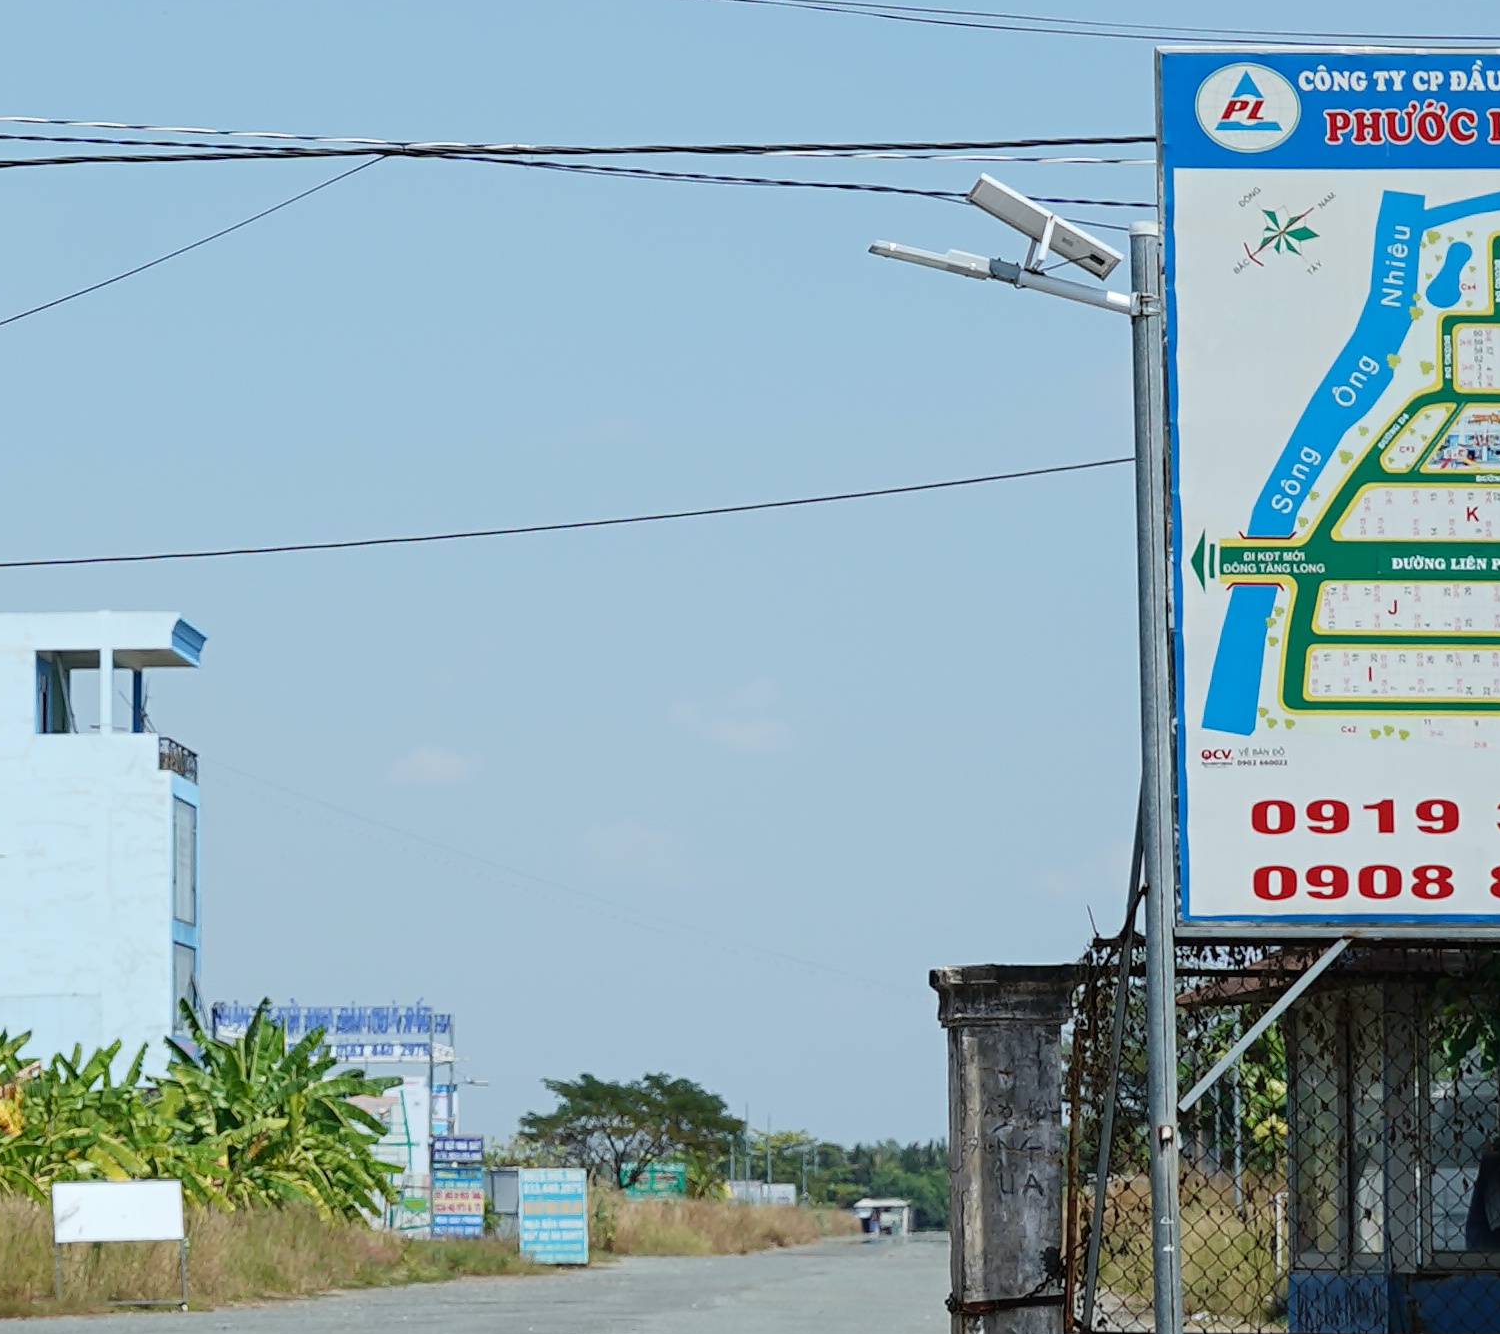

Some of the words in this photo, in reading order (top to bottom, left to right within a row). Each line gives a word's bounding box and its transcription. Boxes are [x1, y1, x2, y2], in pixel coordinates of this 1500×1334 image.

[1298, 64, 1367, 91] CÔNG
[1373, 70, 1405, 91] TY
[1412, 70, 1444, 91] CP
[1220, 100, 1266, 120] PL
[1325, 100, 1477, 145] PHƯỚC
[1271, 445, 1322, 514] Sông
[1331, 353, 1380, 408] Ông
[1380, 225, 1412, 307] Nhiêu
[1466, 506, 1479, 522] K
[1293, 563, 1326, 573] LONG
[1392, 556, 1446, 570] ĐƯỜNG
[1450, 555, 1487, 570] LIÊN
[1388, 599, 1398, 615] J
[1251, 799, 1460, 834] 0919
[1253, 865, 1455, 900] 0908
